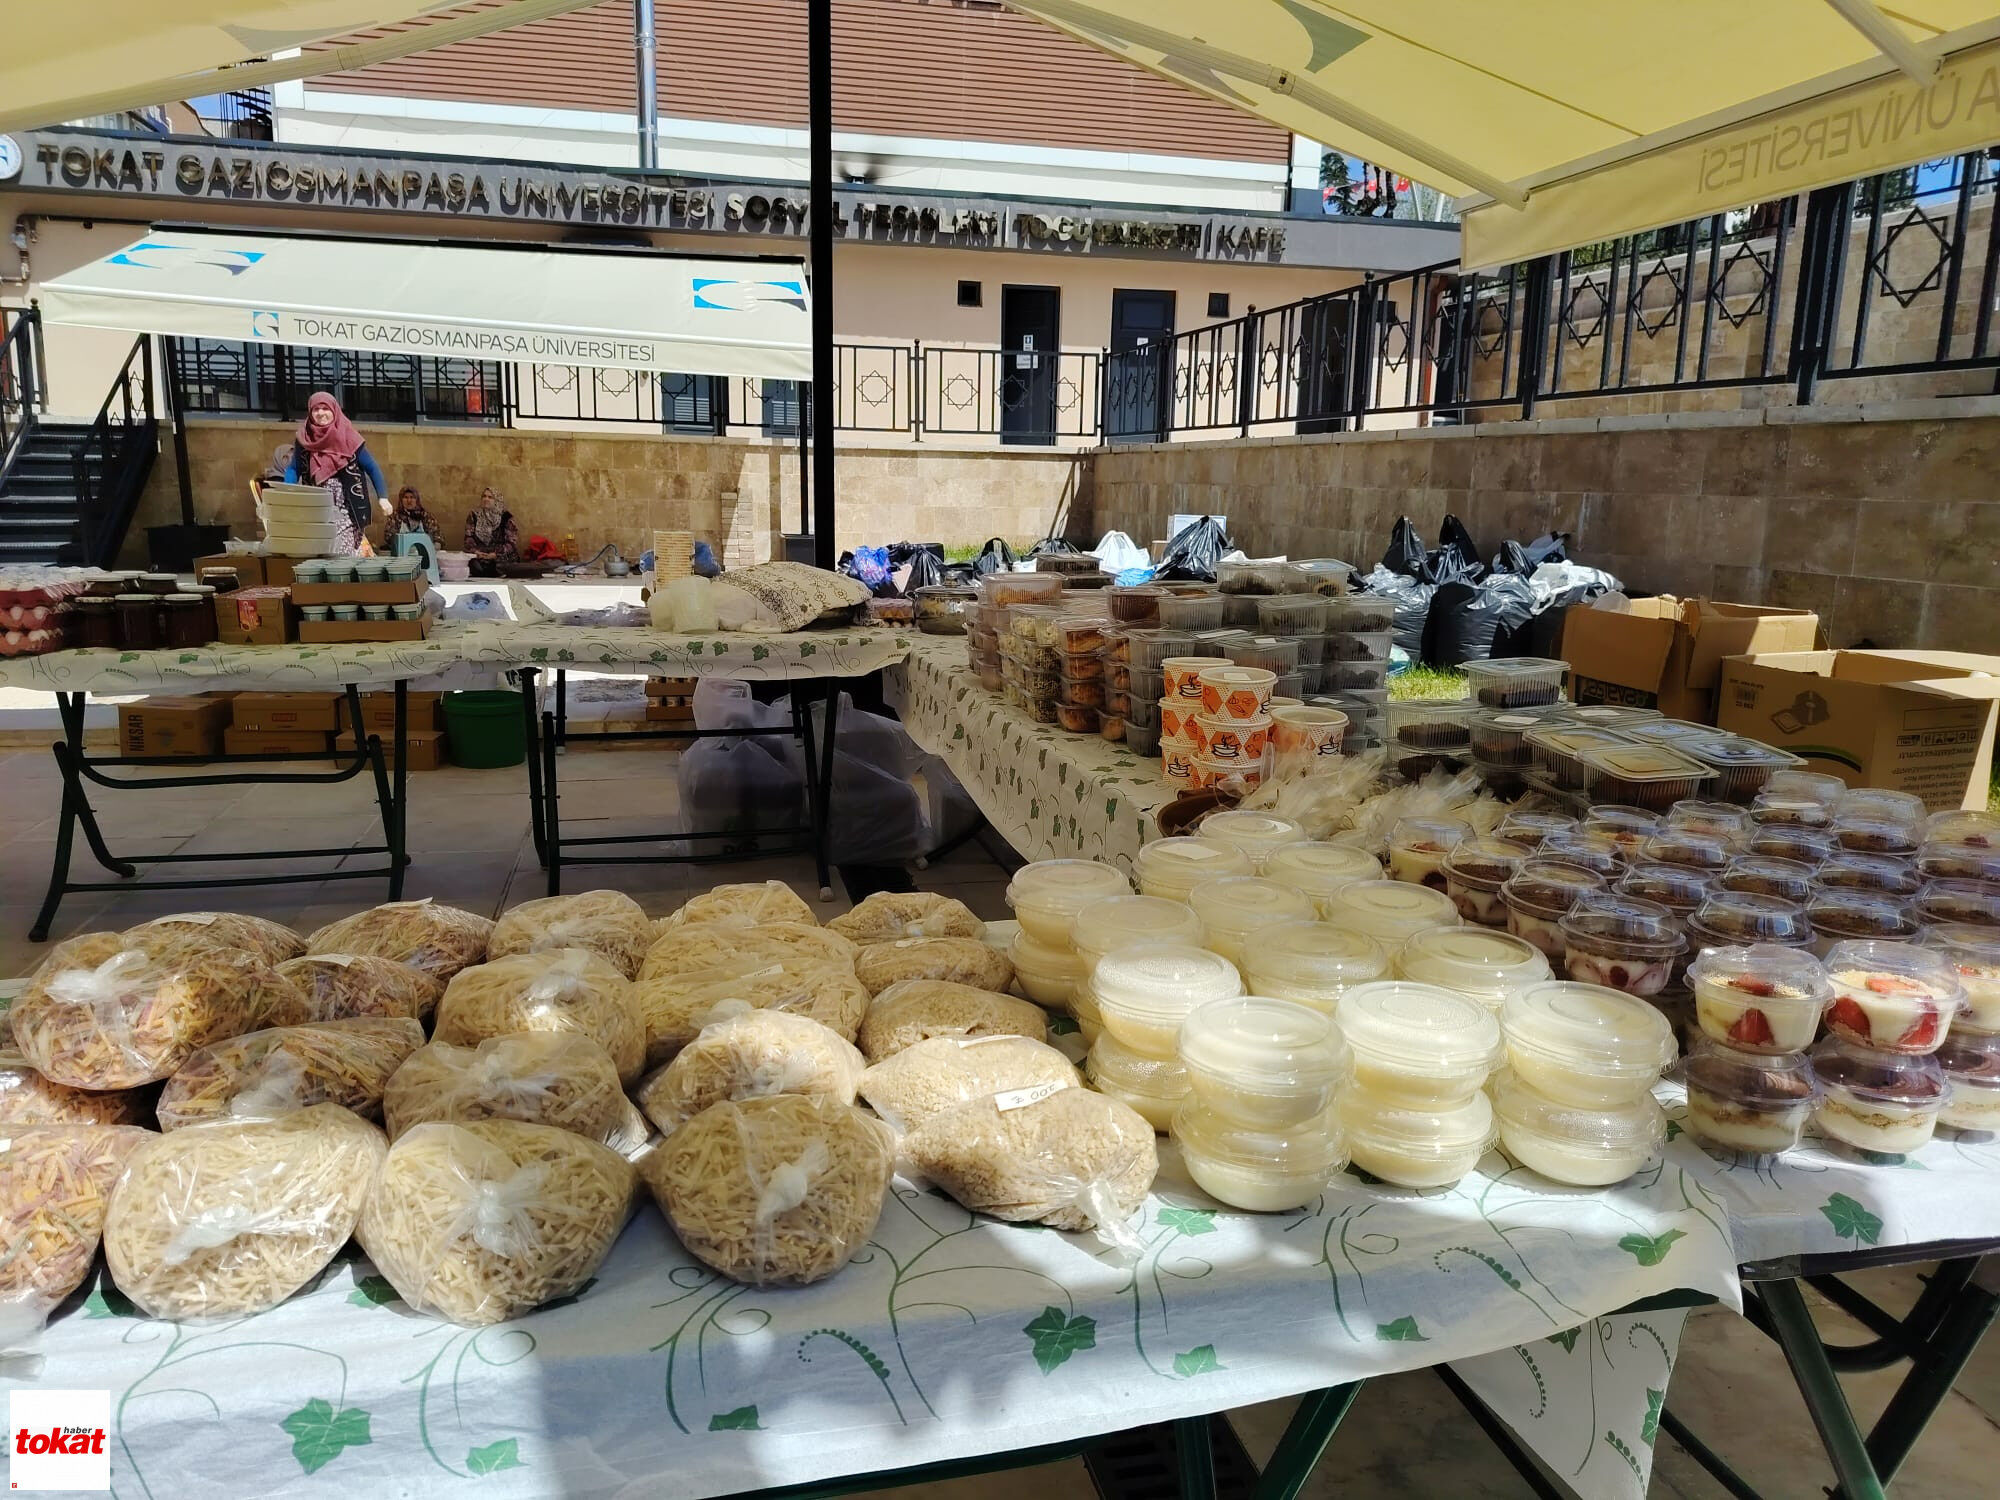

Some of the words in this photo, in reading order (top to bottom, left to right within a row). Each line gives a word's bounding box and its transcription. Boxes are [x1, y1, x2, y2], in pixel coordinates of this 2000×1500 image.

[36, 144, 165, 188] TOKAT
[724, 193, 849, 234] SOSYL
[1217, 225, 1287, 257] KAFE
[293, 318, 358, 340] TOKAT
[362, 323, 529, 354] GAZİOSMANPAŞA
[532, 335, 656, 362] ÜNİVERSİTESİ
